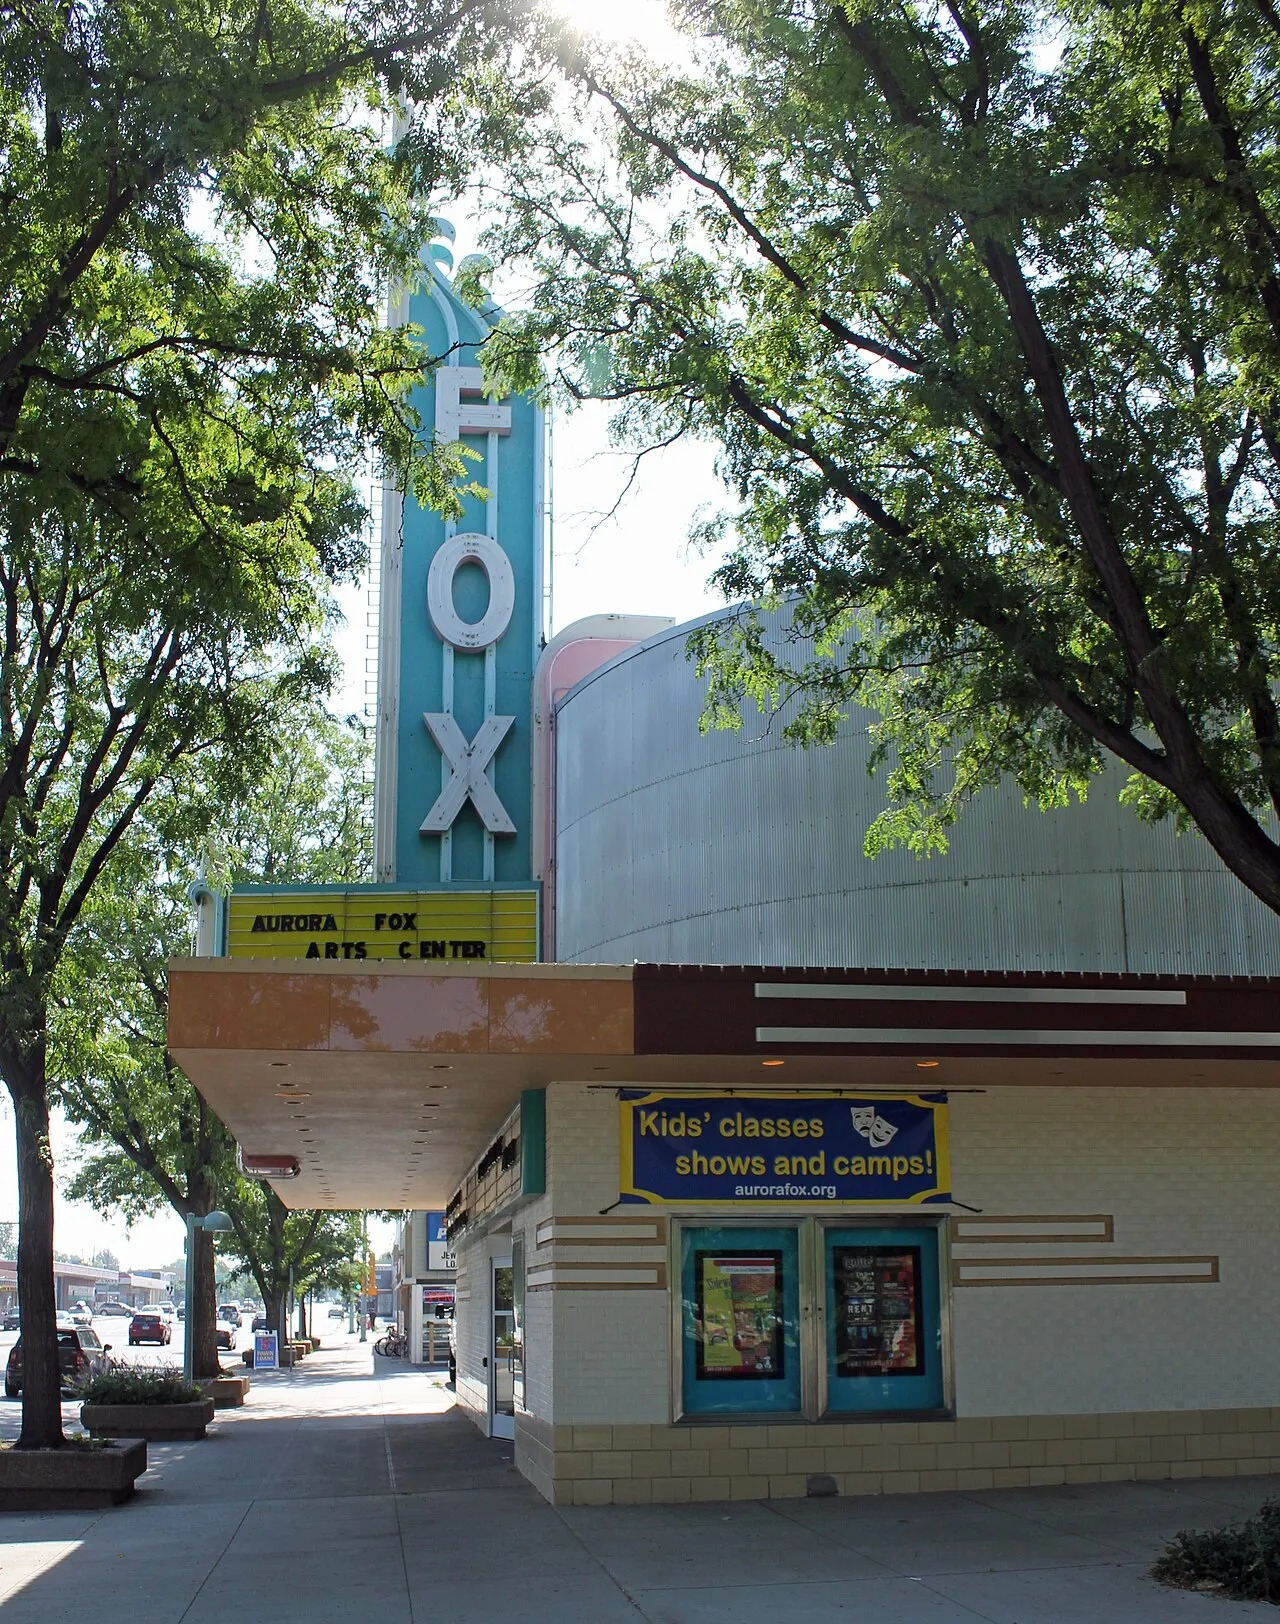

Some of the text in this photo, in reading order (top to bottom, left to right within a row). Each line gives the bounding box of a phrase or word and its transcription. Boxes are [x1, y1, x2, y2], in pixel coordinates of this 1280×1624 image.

[419, 366, 517, 837] FOX
[251, 912, 417, 932] AURORA FOX
[305, 941, 368, 959] ARTS
[639, 1110, 825, 1138] Kids' classes
[675, 1150, 934, 1182] shows and camps!
[735, 1183, 837, 1199] aurorafox.org
